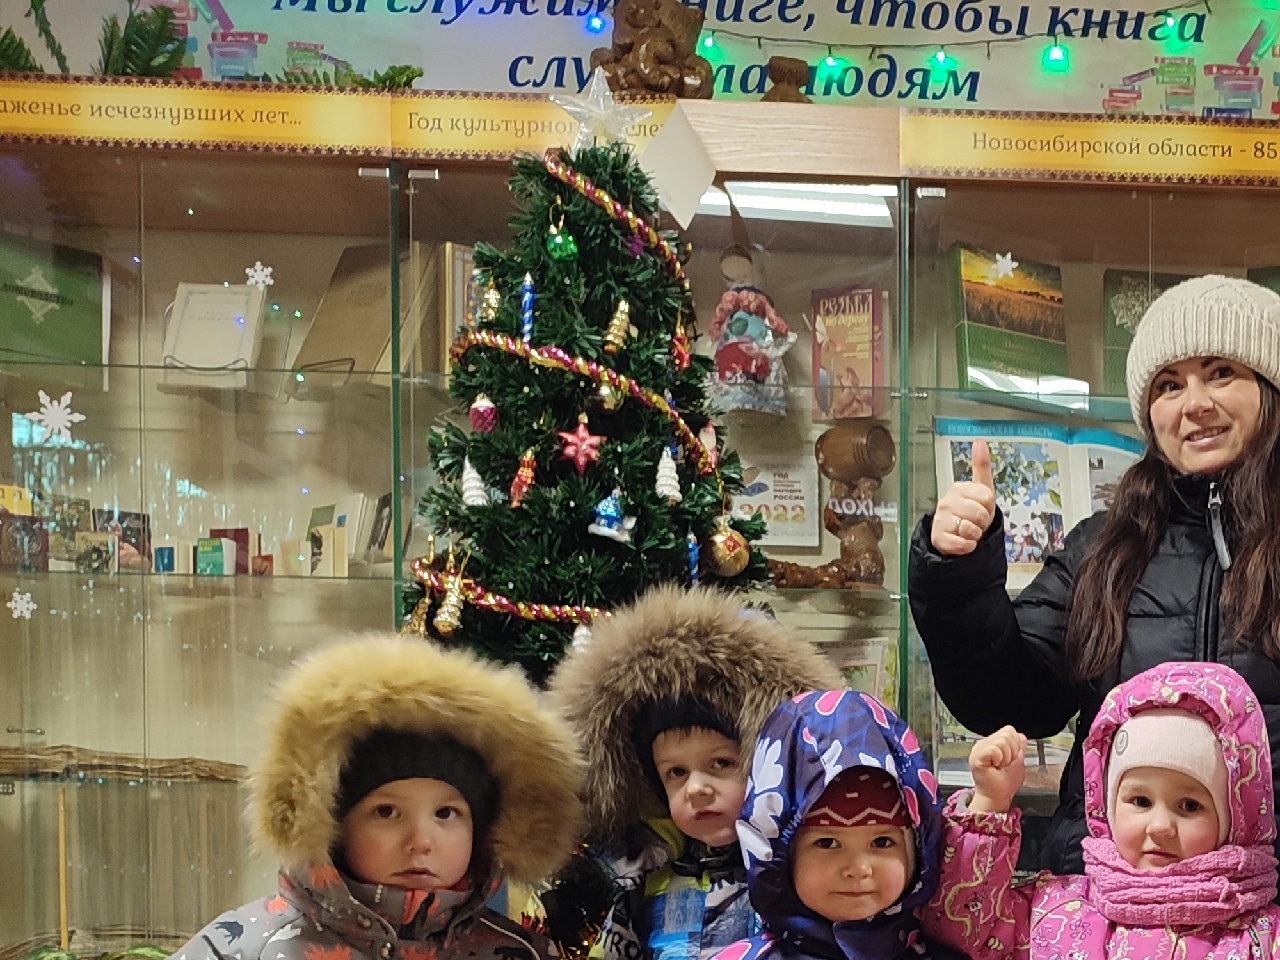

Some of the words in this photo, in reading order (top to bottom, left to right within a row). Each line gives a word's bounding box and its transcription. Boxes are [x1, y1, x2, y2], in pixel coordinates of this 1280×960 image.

[836, 0, 1028, 36] чтобы
[1046, 6, 1209, 42] книга
[90, 102, 245, 126] исчезнувших
[252, 109, 302, 125] лет...
[408, 112, 443, 131] Год
[450, 117, 578, 137] культурног
[973, 132, 1141, 158] Новосибирской
[1148, 139, 1233, 157] области
[1253, 142, 1278, 159] 85
